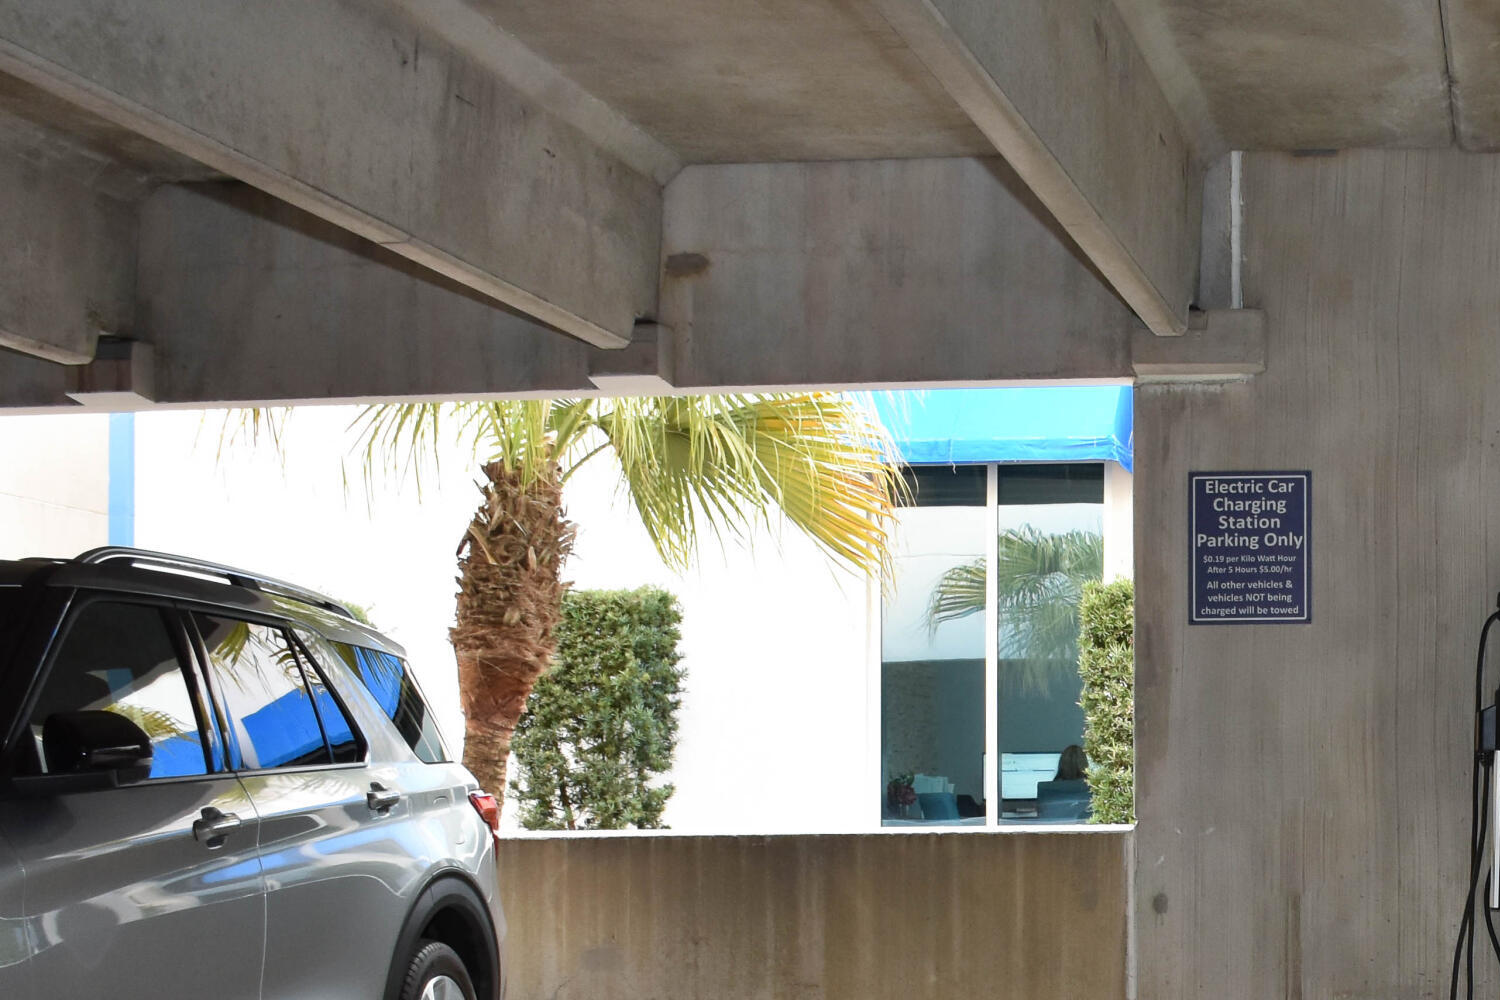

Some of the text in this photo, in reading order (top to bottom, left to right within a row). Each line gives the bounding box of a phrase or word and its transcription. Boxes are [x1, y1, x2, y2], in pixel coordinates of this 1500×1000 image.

[1205, 479, 1295, 494] Electric Car
[1213, 496, 1287, 514] Charging
[1218, 514, 1281, 530] Station
[1197, 531, 1304, 550] Parking Only
[1225, 555, 1239, 564] per
[1240, 554, 1256, 563] Kilo
[1257, 554, 1276, 563] Watt
[1277, 554, 1297, 563] Hour
[1207, 565, 1227, 574] After
[1228, 565, 1234, 574] 5
[1234, 565, 1258, 574] Hours
[1206, 579, 1293, 590] All other vehicles &
[1207, 592, 1293, 603] vehicles NOT being
[1200, 605, 1299, 617] charged will be towed
